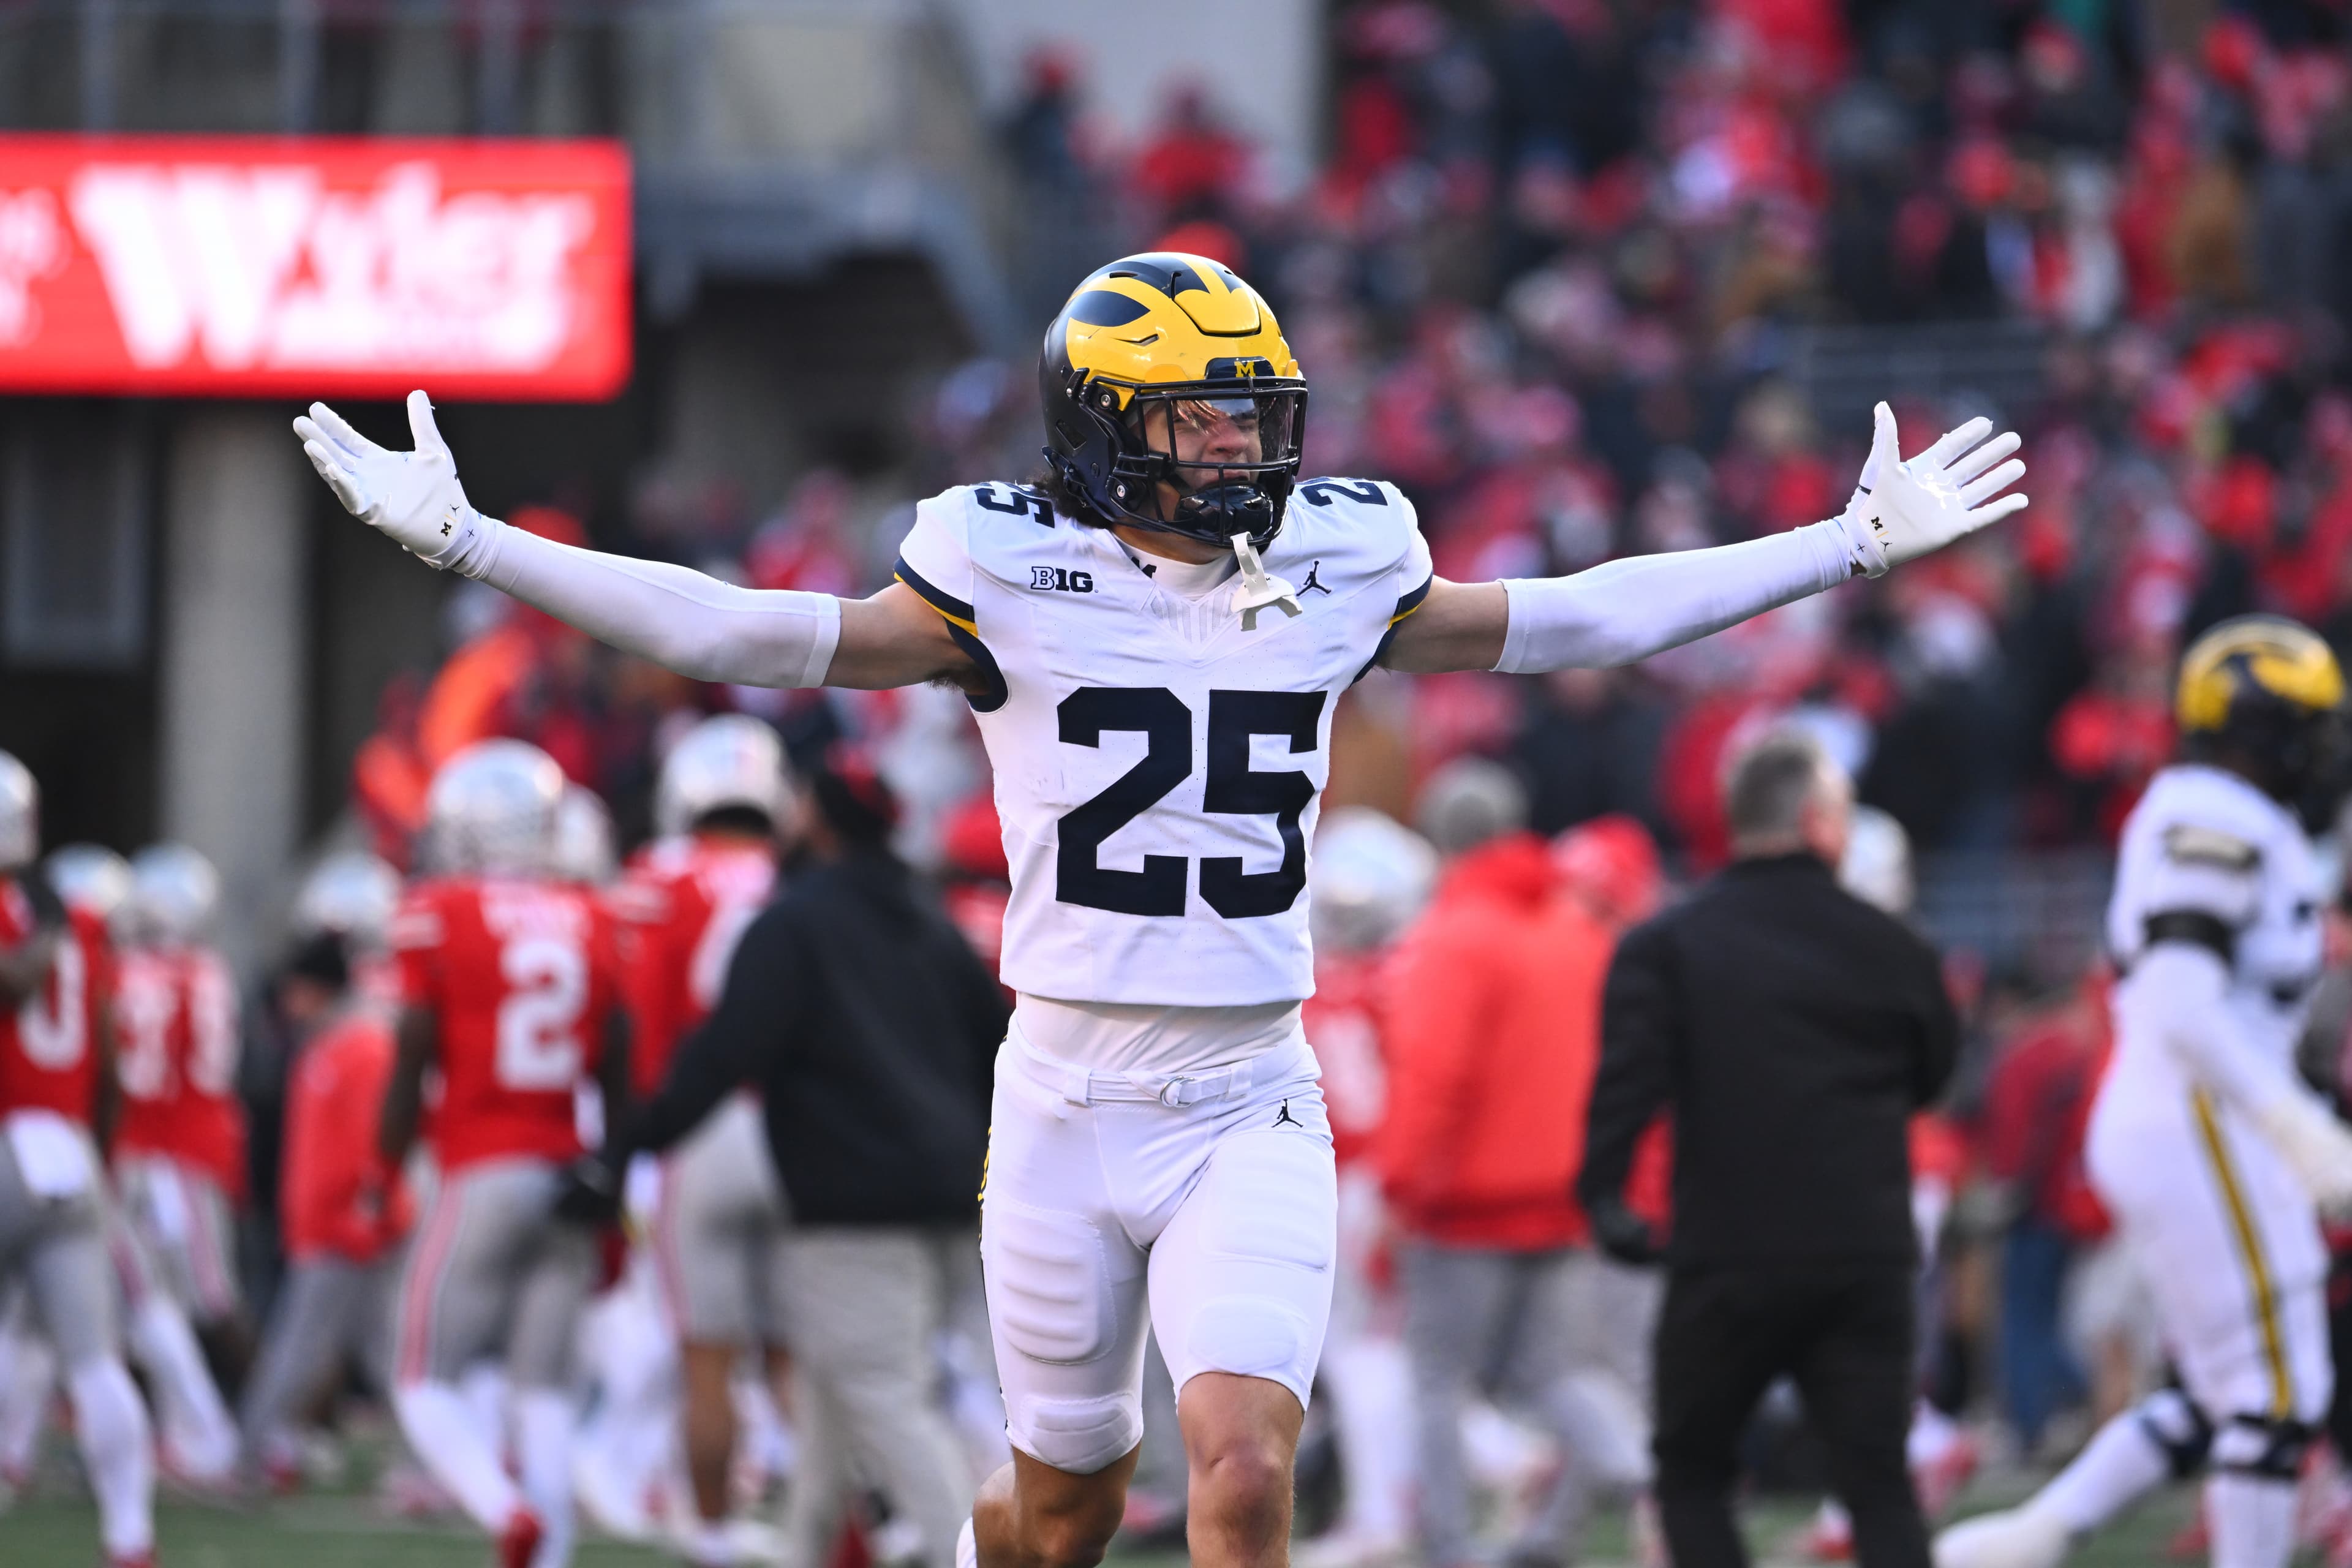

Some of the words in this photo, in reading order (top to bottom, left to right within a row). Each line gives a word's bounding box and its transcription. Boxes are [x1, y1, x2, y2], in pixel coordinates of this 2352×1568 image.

[1234, 361, 1256, 378] M
[440, 522, 452, 537] M
[1871, 516, 1883, 531] M
[1056, 686, 1328, 919] 25
[495, 940, 587, 1091] 2
